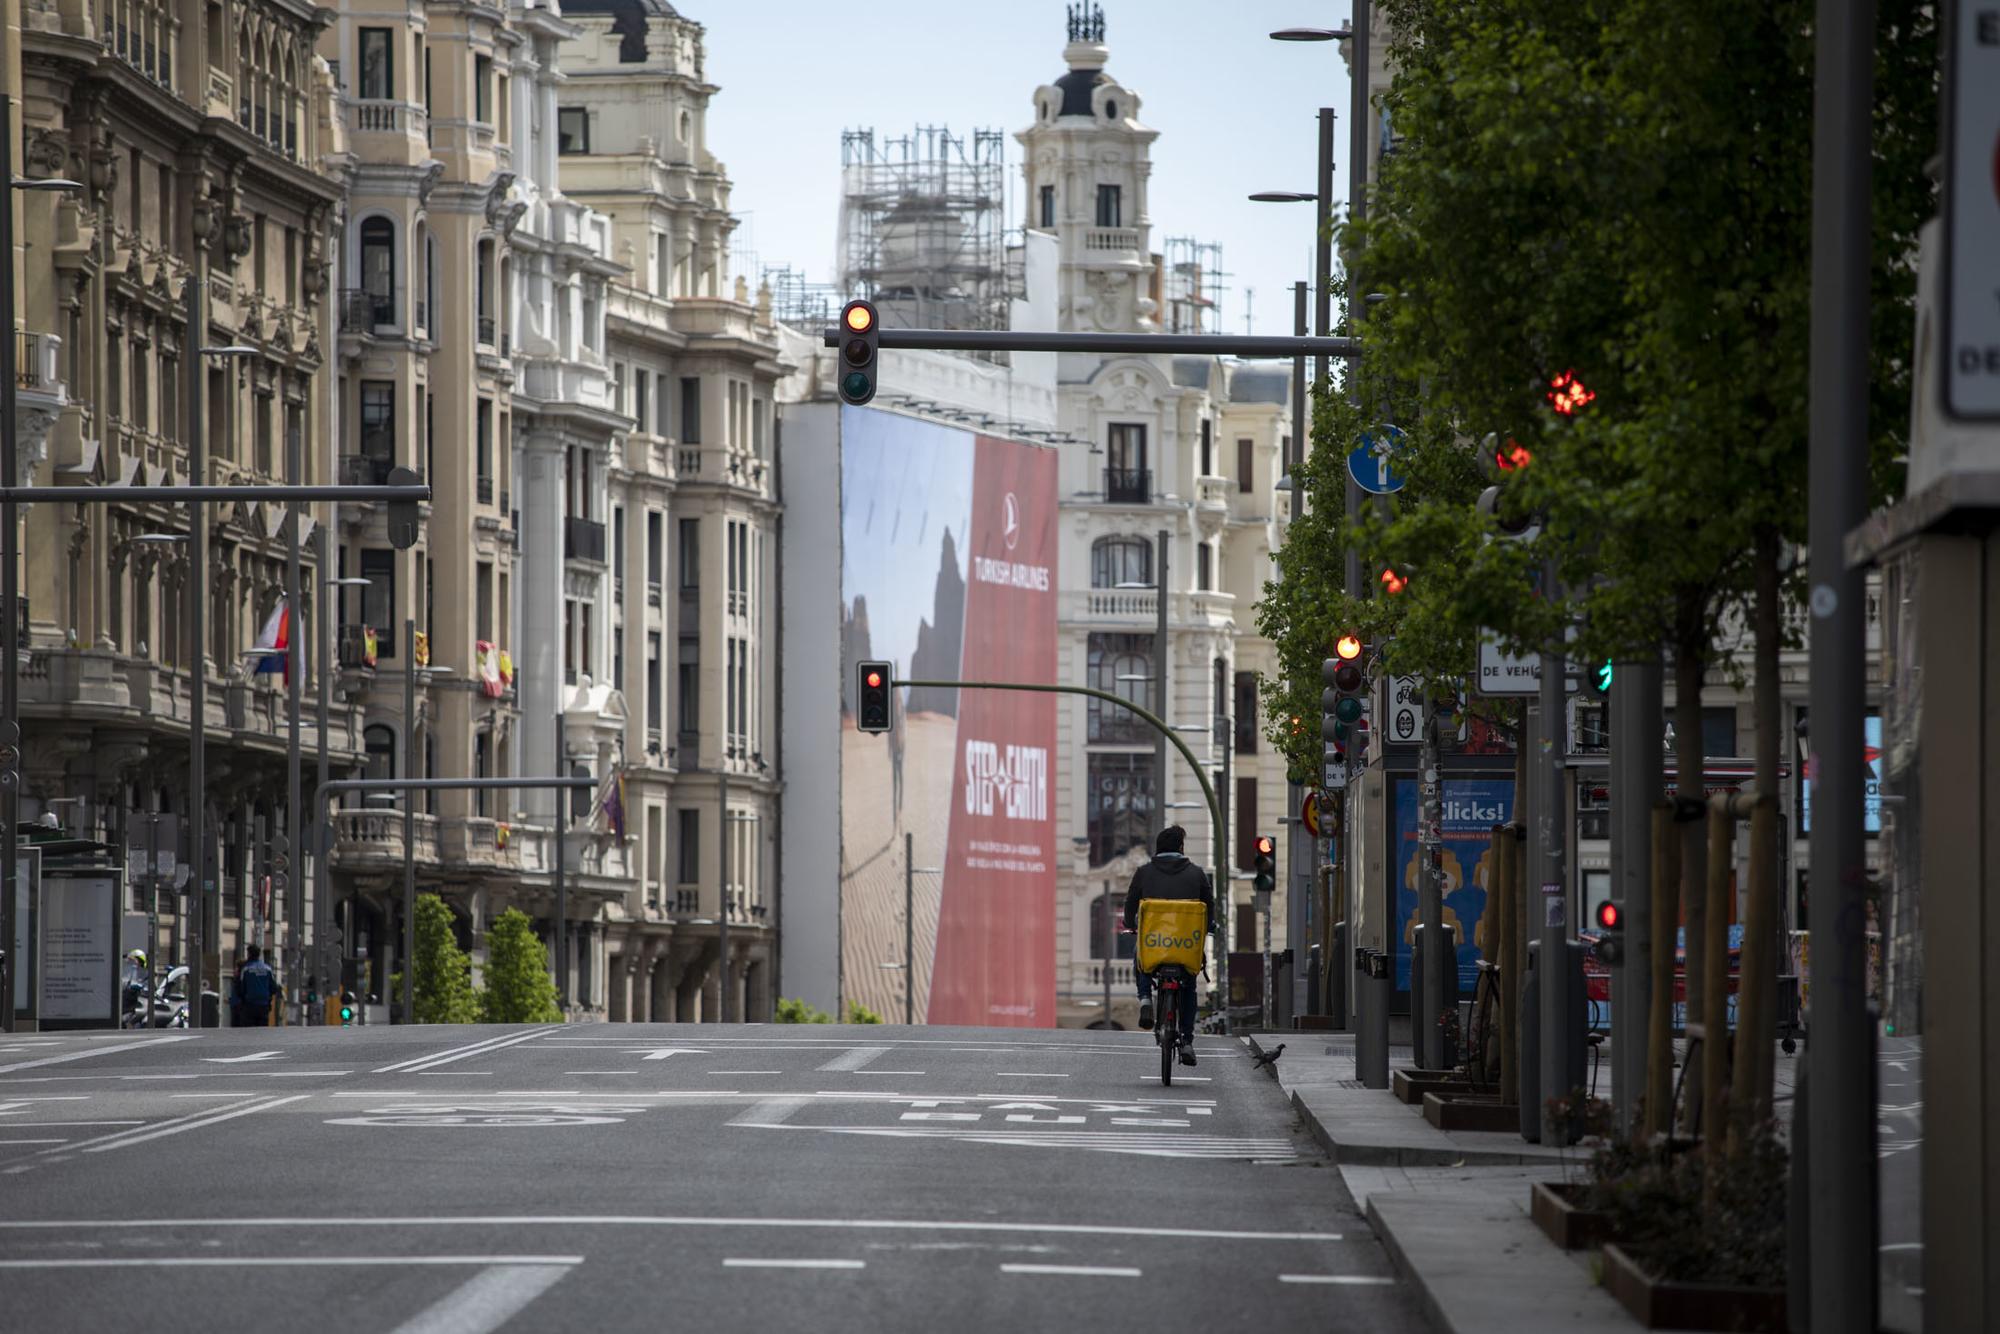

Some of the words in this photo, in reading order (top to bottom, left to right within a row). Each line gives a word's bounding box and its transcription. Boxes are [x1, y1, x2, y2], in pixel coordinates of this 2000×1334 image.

[1483, 667, 1499, 676] DE
[1145, 933, 1194, 949] Glovo
[889, 1099, 1212, 1115] TAXI
[899, 1112, 1190, 1127] BUS
